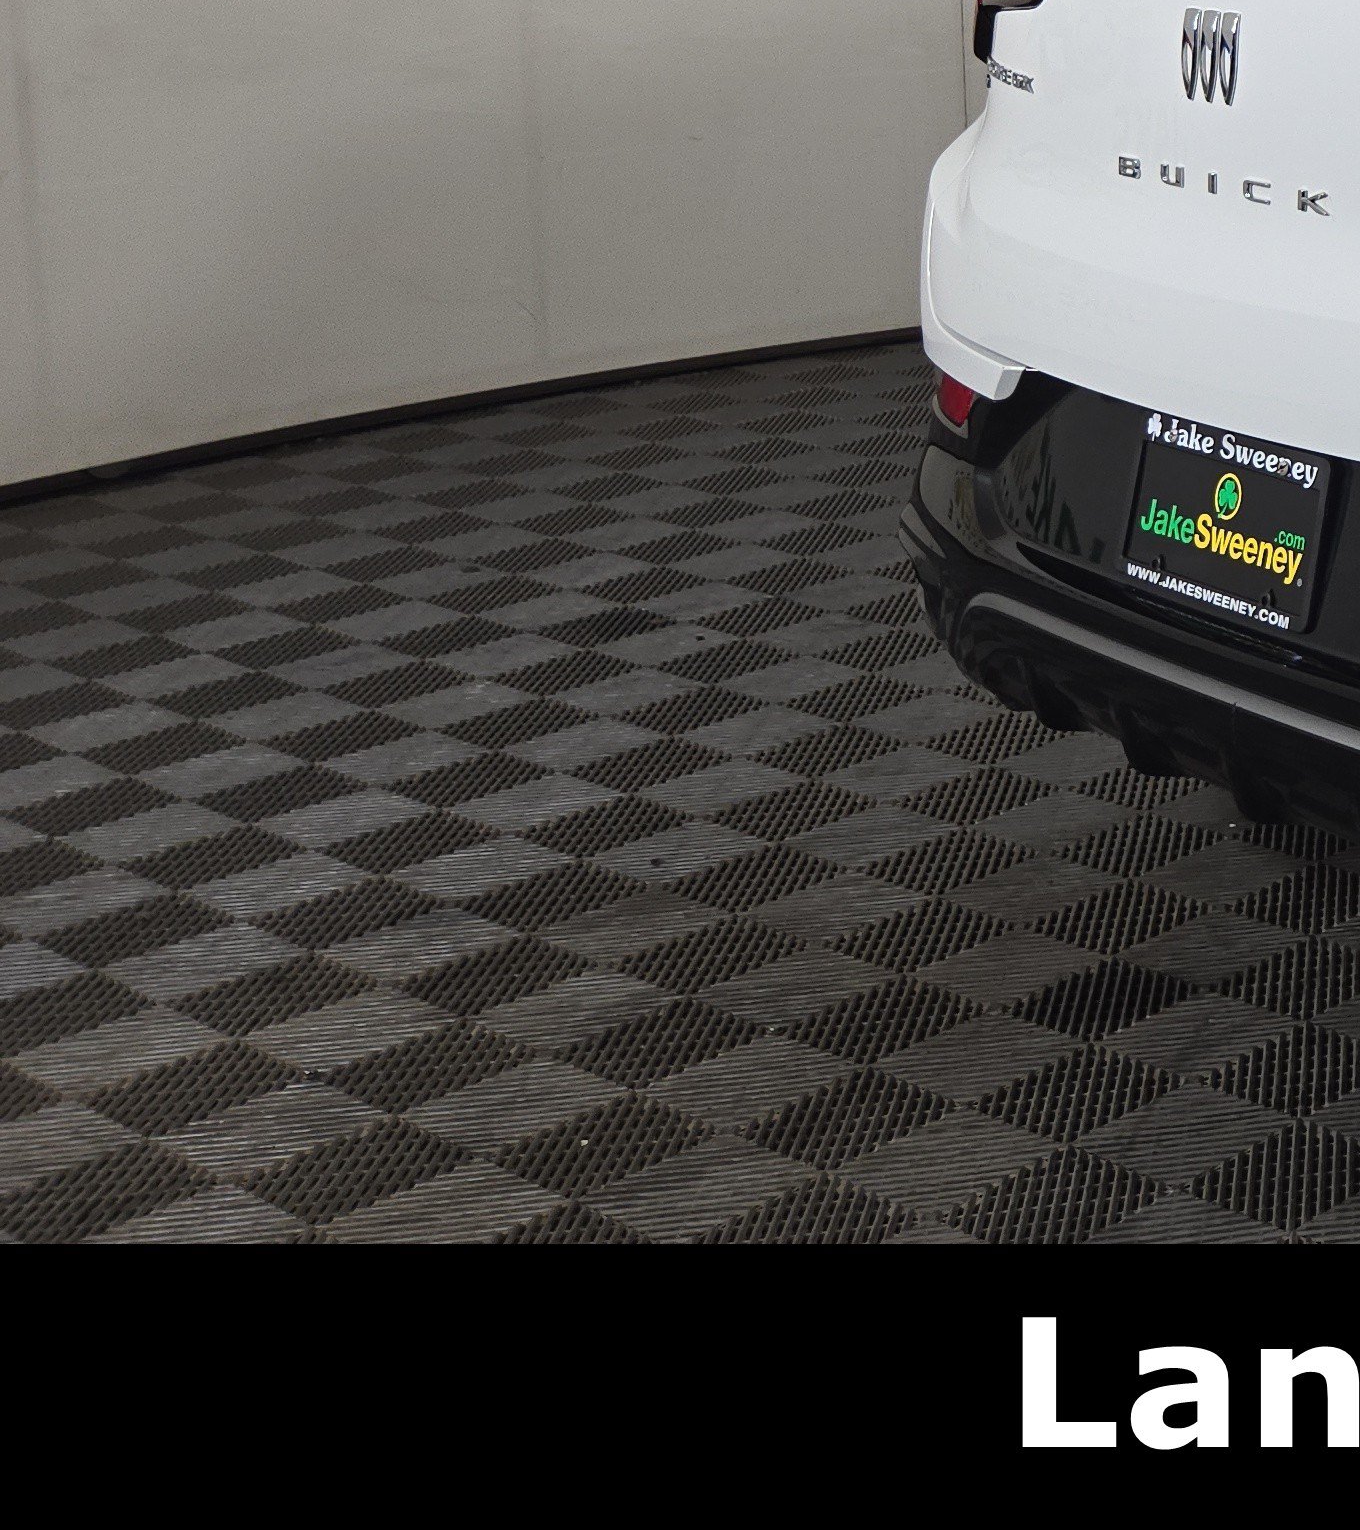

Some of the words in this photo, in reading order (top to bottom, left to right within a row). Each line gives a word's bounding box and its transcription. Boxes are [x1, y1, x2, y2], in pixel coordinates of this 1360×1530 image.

[1118, 156, 1330, 218] BUICK
[1163, 418, 1215, 455] Jake
[1126, 562, 1291, 630] WWW.JAKESWEENEY.COM
